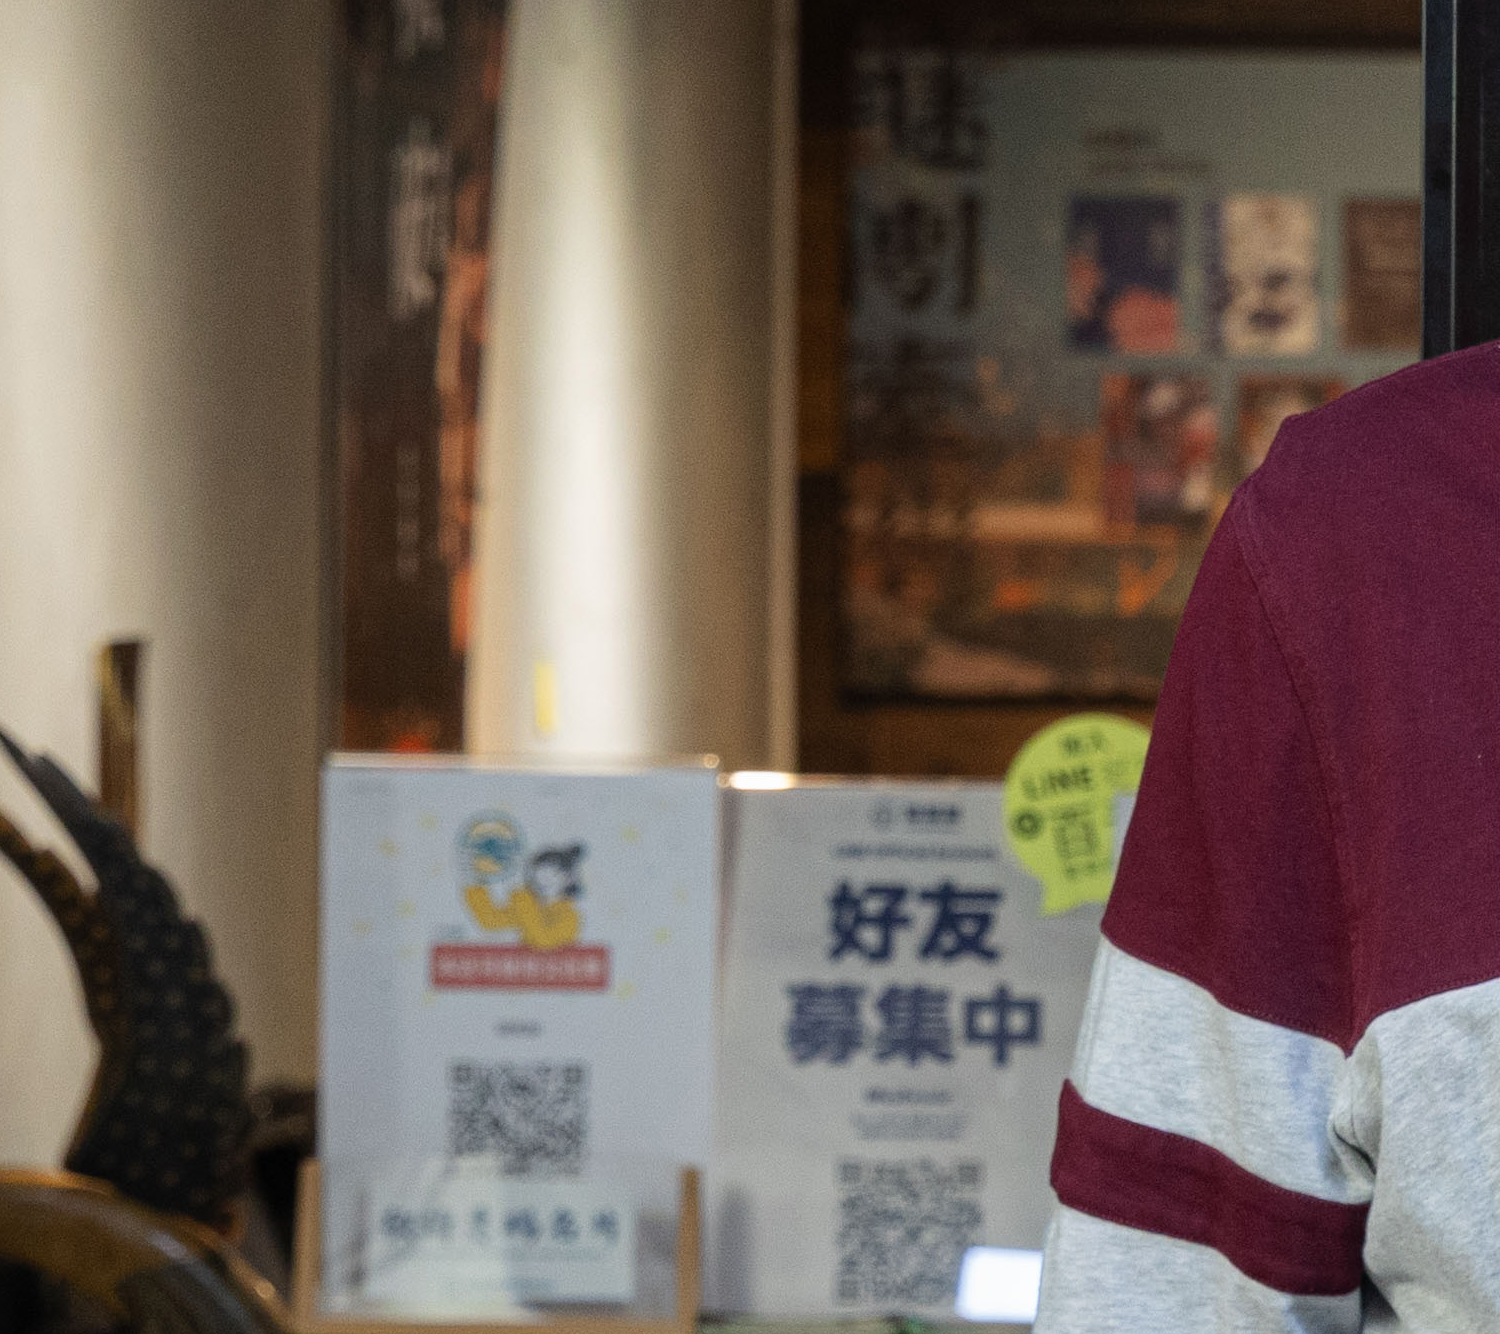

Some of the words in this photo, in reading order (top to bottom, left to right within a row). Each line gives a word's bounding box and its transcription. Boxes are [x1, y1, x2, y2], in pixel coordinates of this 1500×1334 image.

[826, 879, 1004, 966] 好友
[783, 982, 1044, 1070] 募集中
